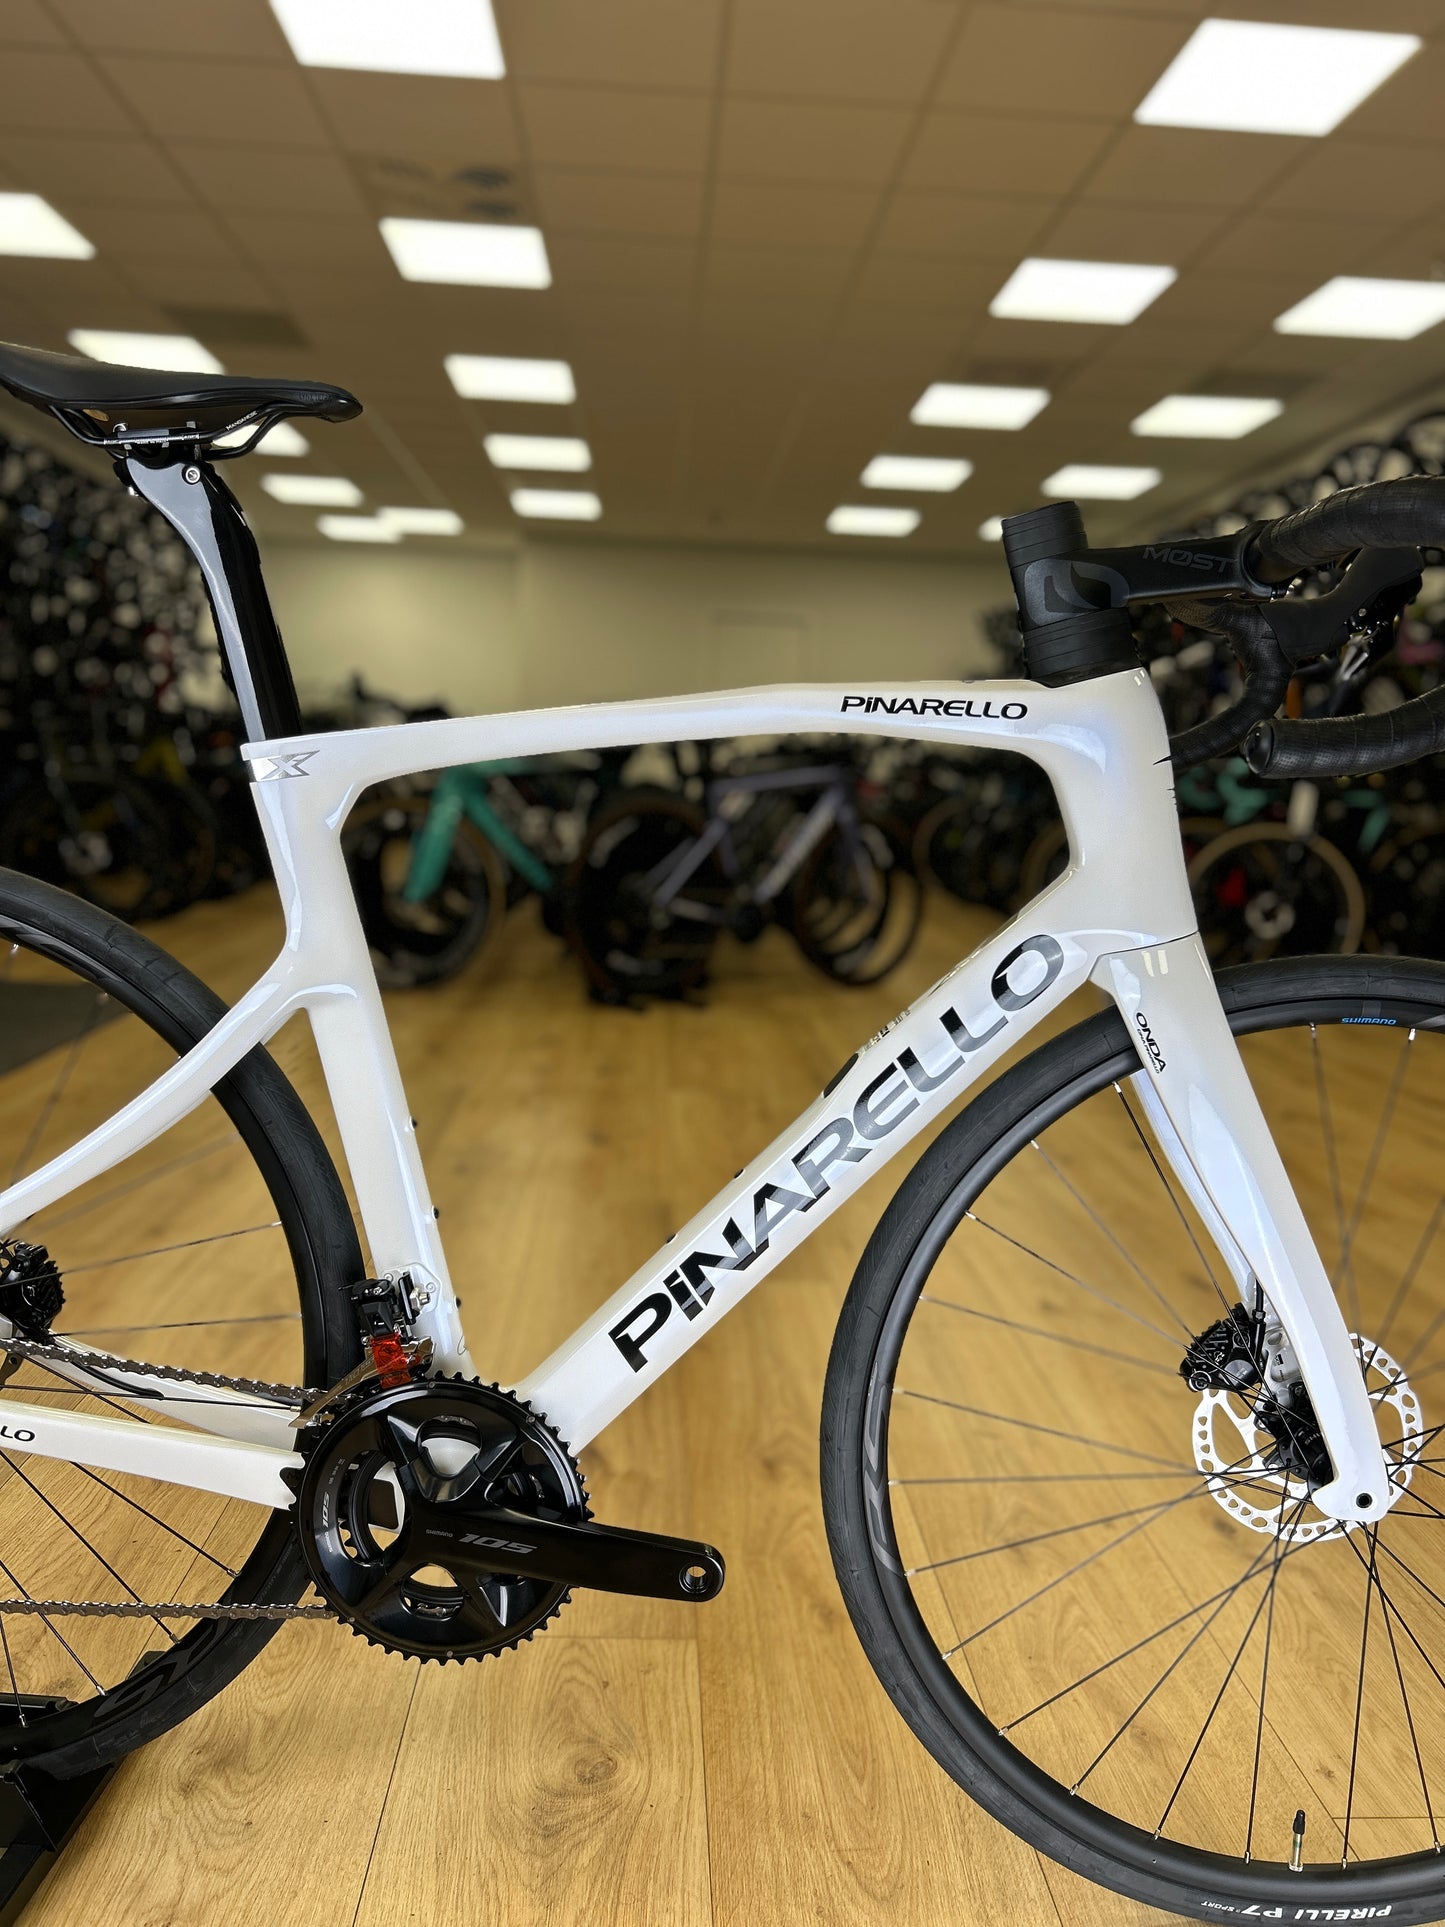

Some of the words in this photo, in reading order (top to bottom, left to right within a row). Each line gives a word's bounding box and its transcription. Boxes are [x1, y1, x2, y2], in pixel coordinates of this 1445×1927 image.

[1341, 1017, 1397, 1026] SHIMANO
[1136, 1012, 1167, 1073] ONDA
[322, 1491, 330, 1528] 105
[425, 1528, 454, 1538] SHIMANO
[459, 1533, 538, 1554] 105
[1200, 1900, 1235, 1913] SPORT
[1294, 1905, 1392, 1921] PIRELLI
